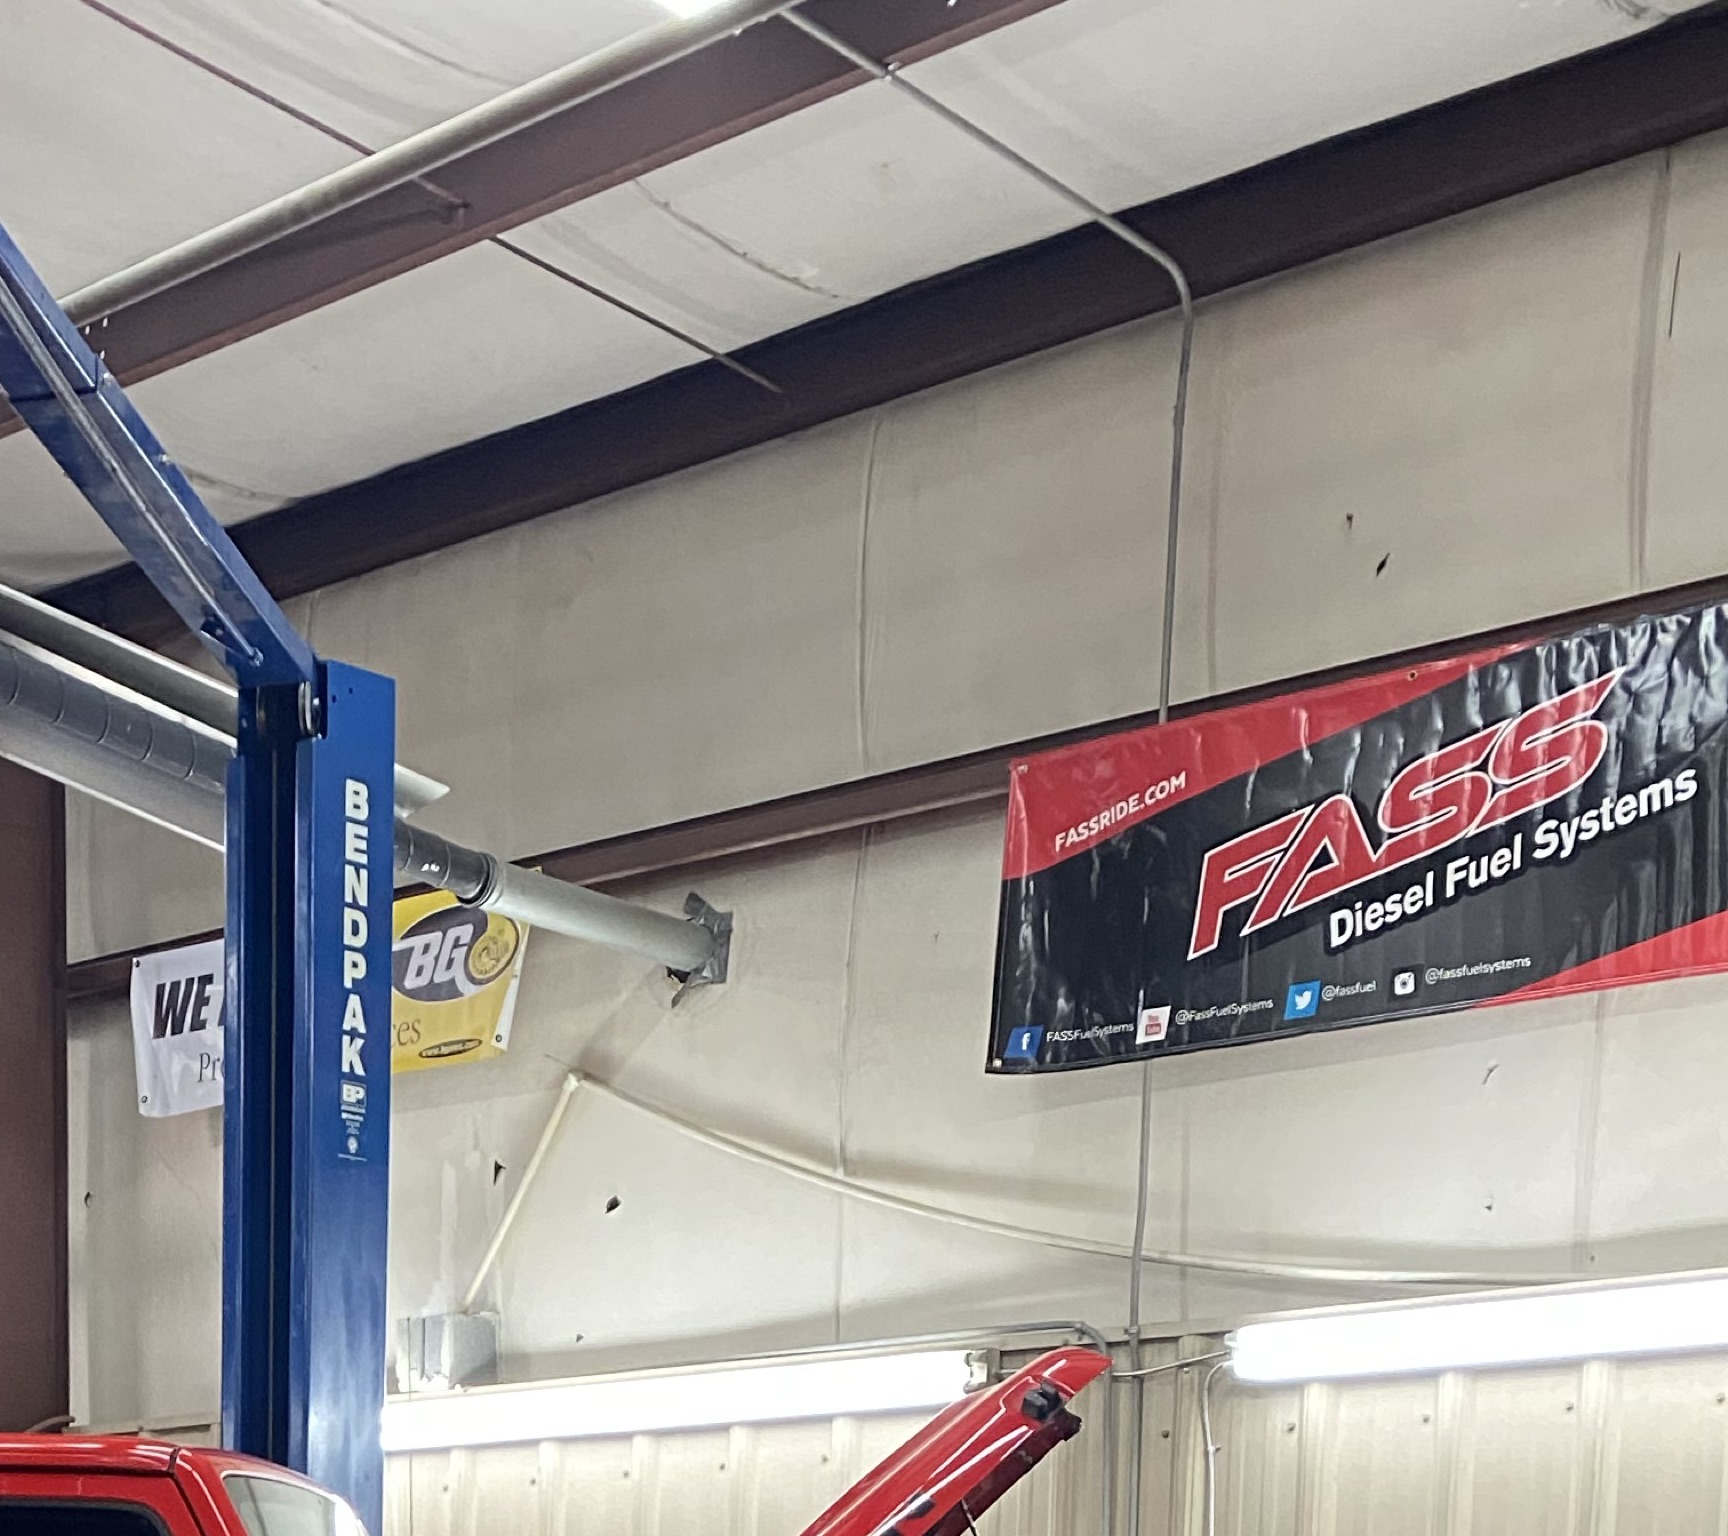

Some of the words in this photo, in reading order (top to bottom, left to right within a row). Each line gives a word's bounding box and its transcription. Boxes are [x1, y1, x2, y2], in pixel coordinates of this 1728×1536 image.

[1055, 770, 1186, 853] FASSRIDE.COM
[1187, 666, 1625, 960] FASS
[1329, 871, 1434, 948] Diesel
[1445, 833, 1522, 898] Fuel
[1531, 768, 1698, 858] Systems
[341, 778, 369, 1077] BENDPAK
[398, 923, 474, 990] BG
[1321, 980, 1377, 1001] @fassfuel
[1425, 956, 1532, 985] @fassfuelsystems
[152, 973, 214, 1040] WE
[1046, 1022, 1134, 1042] FASSFuelSystems
[1175, 998, 1274, 1026] @FassFuelSystems
